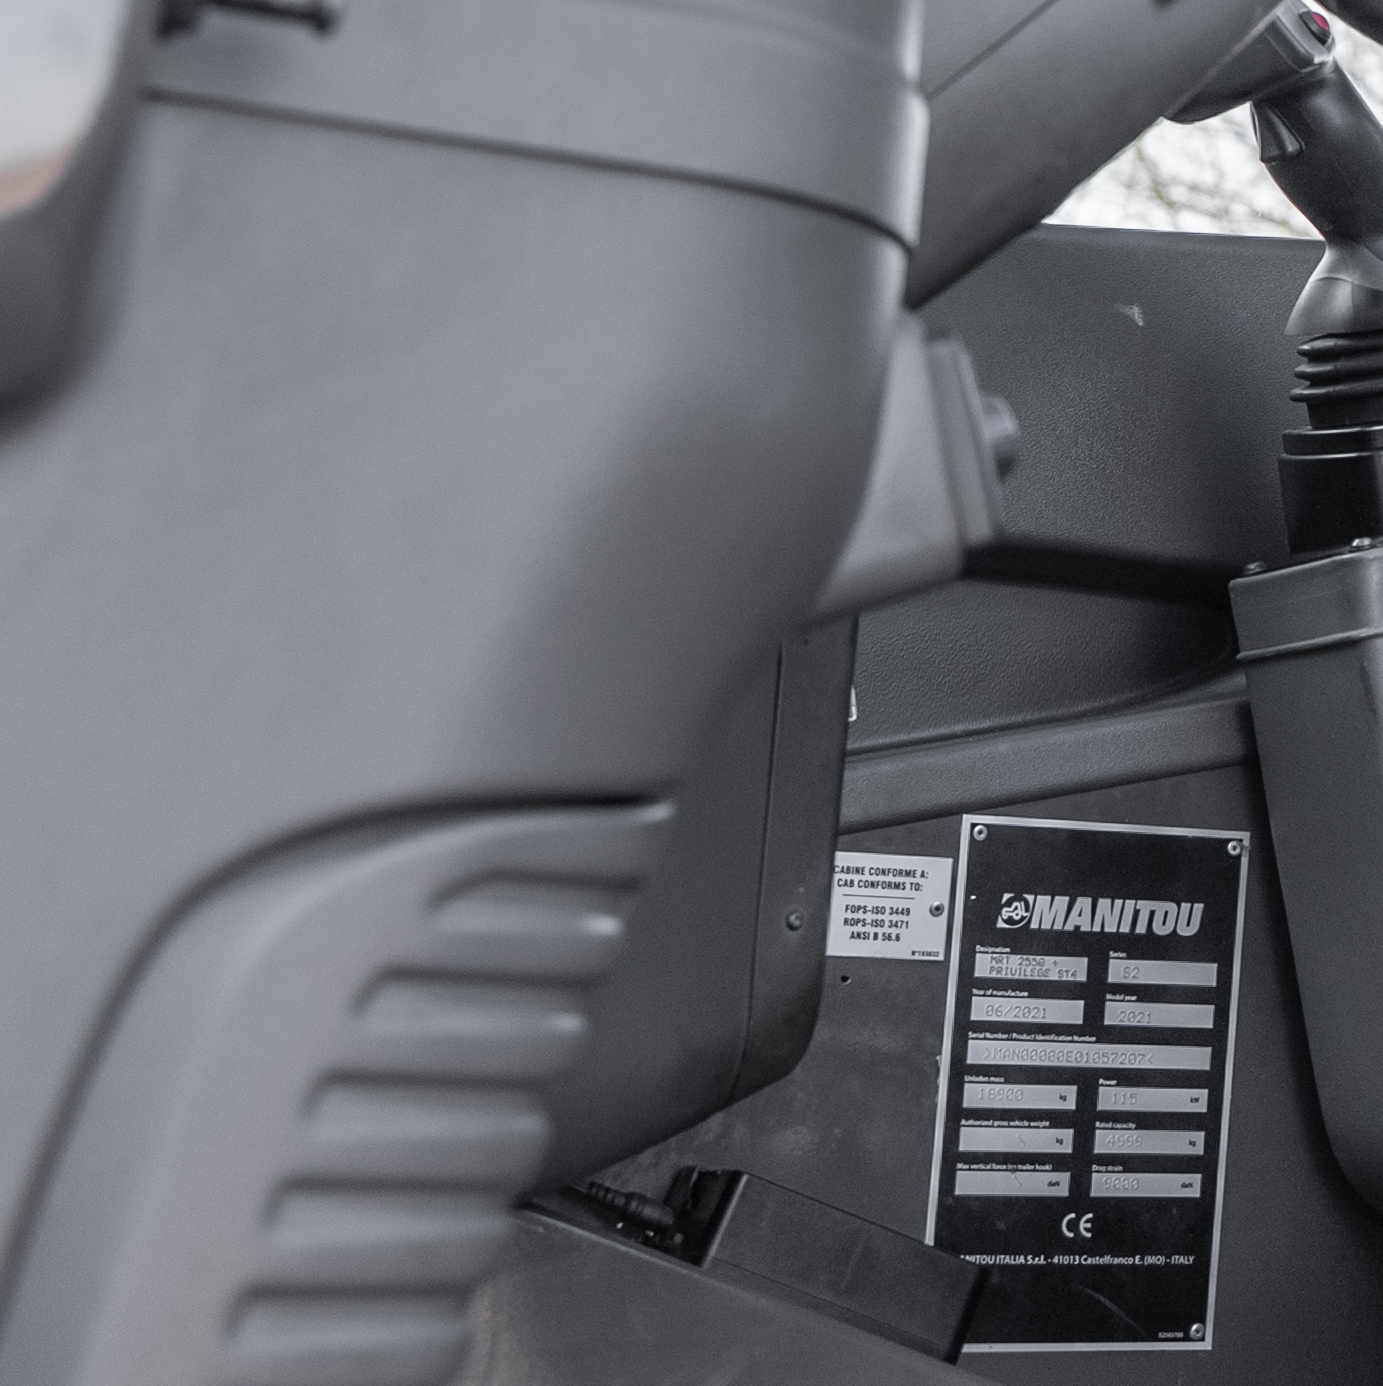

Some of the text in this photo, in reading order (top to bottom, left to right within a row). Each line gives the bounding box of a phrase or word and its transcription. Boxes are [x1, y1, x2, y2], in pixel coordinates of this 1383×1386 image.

[834, 865, 929, 879] CABINE CONFORME A:
[837, 878, 923, 892] CAB CONFORMS TO:
[845, 904, 911, 916] FOPS-ISO 3449
[1030, 895, 1204, 936] MANITOU
[844, 917, 909, 929] ROPS-ISO 3471
[850, 931, 901, 942] ANSI B 56.6
[976, 945, 1011, 953] Designation
[989, 956, 1011, 965] MRT
[1018, 957, 1045, 967] 2550
[988, 966, 1051, 978] PRIVILEGE
[1122, 965, 1140, 979] S2
[993, 989, 1029, 997] manufacture
[985, 1004, 1047, 1019] 06/2021
[1117, 1010, 1151, 1024] 2021
[1013, 1033, 1034, 1041] Product
[1035, 1033, 1073, 1041] Identification
[979, 1088, 1067, 1102] 18900 kg
[1111, 1092, 1138, 1105] 115
[1055, 1137, 1064, 1145] kg
[1105, 1134, 1196, 1148] 4999 kg
[1103, 1176, 1139, 1190] 9000
[1061, 1213, 1093, 1237] CE
[960, 1255, 995, 1264] NITOU
[996, 1255, 1025, 1264] ITALIA
[1027, 1255, 1046, 1264] S.r.l.
[1052, 1255, 1079, 1264] 41013
[1081, 1255, 1134, 1264] Castelfranco
[1135, 1255, 1142, 1264] E.
[1144, 1255, 1165, 1265] (MO)
[1171, 1255, 1195, 1264] ITALY
